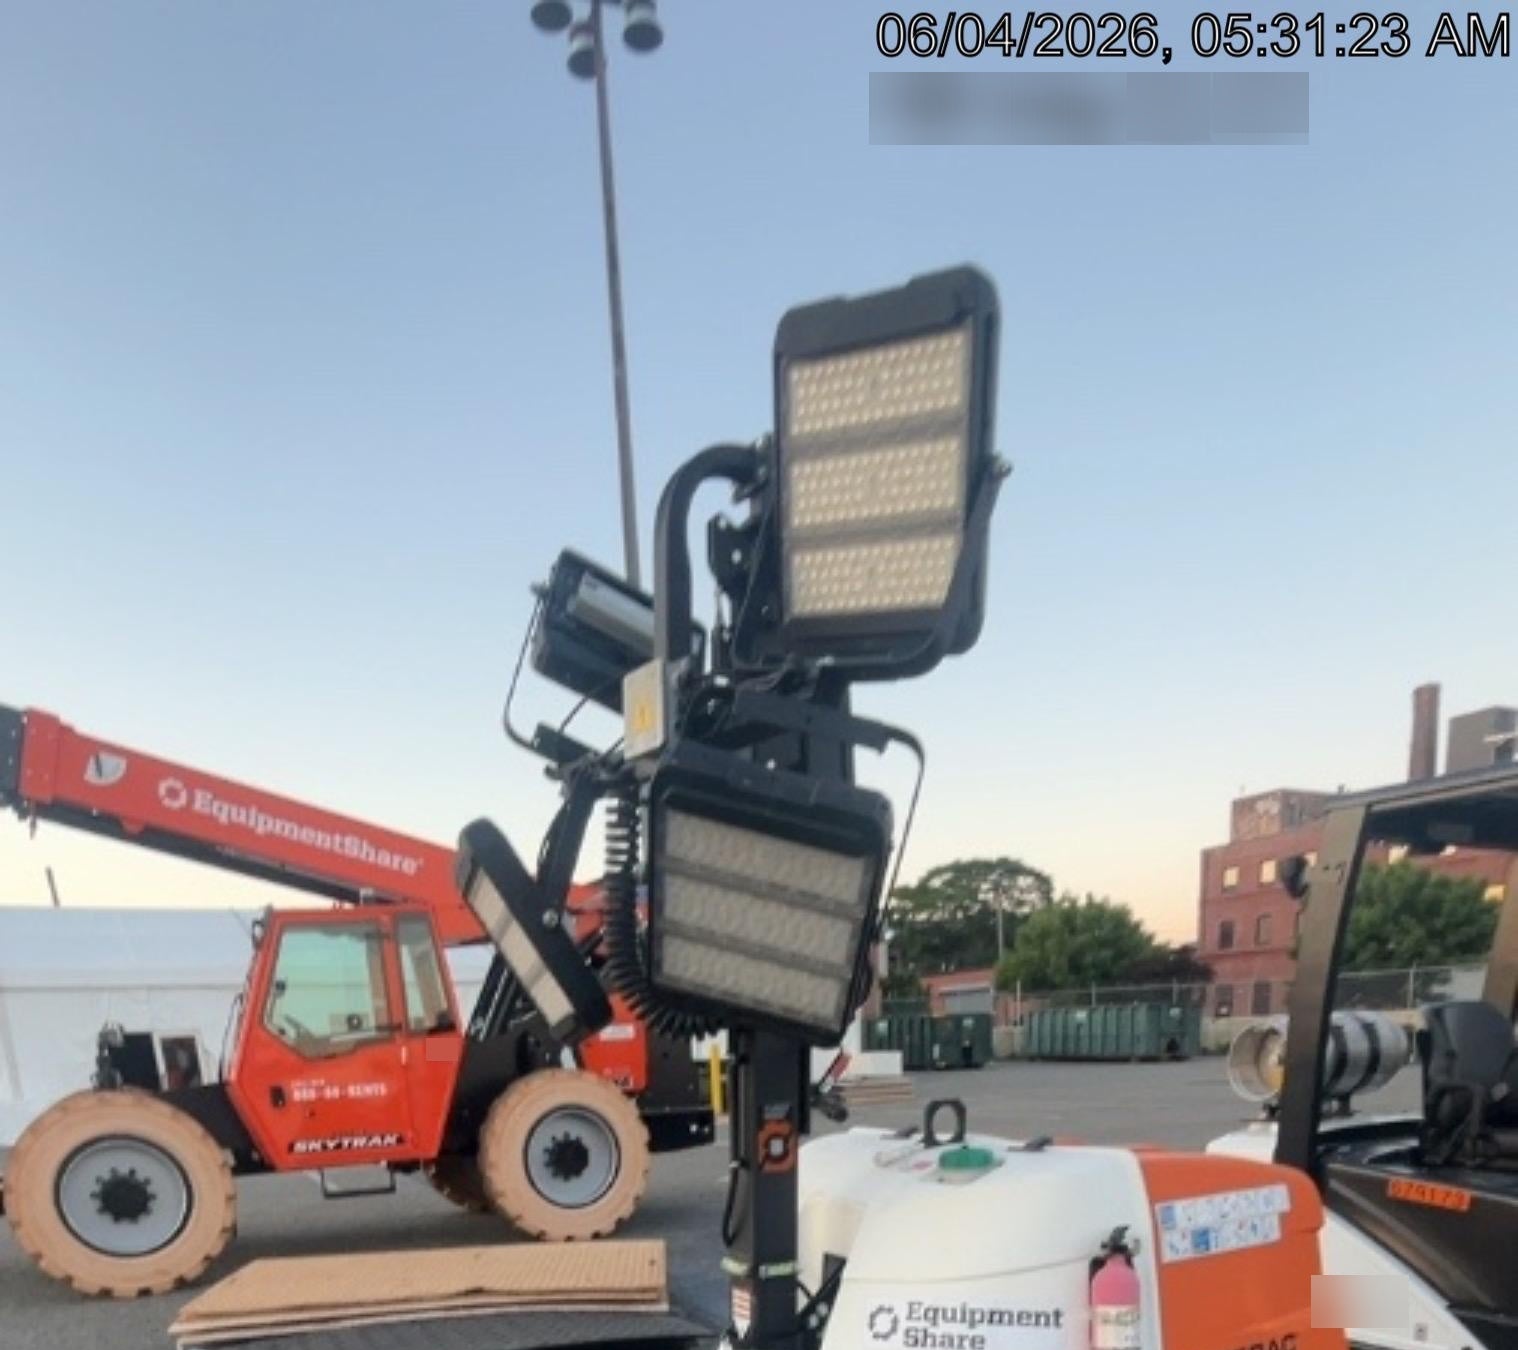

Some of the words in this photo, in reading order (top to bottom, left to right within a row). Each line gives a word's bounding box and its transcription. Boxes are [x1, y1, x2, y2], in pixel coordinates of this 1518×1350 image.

[192, 787, 418, 876] EquipmentShare
[292, 1133, 400, 1153] SKYTRAK
[904, 1300, 1065, 1329] Equipment
[902, 1326, 986, 1350] Share
